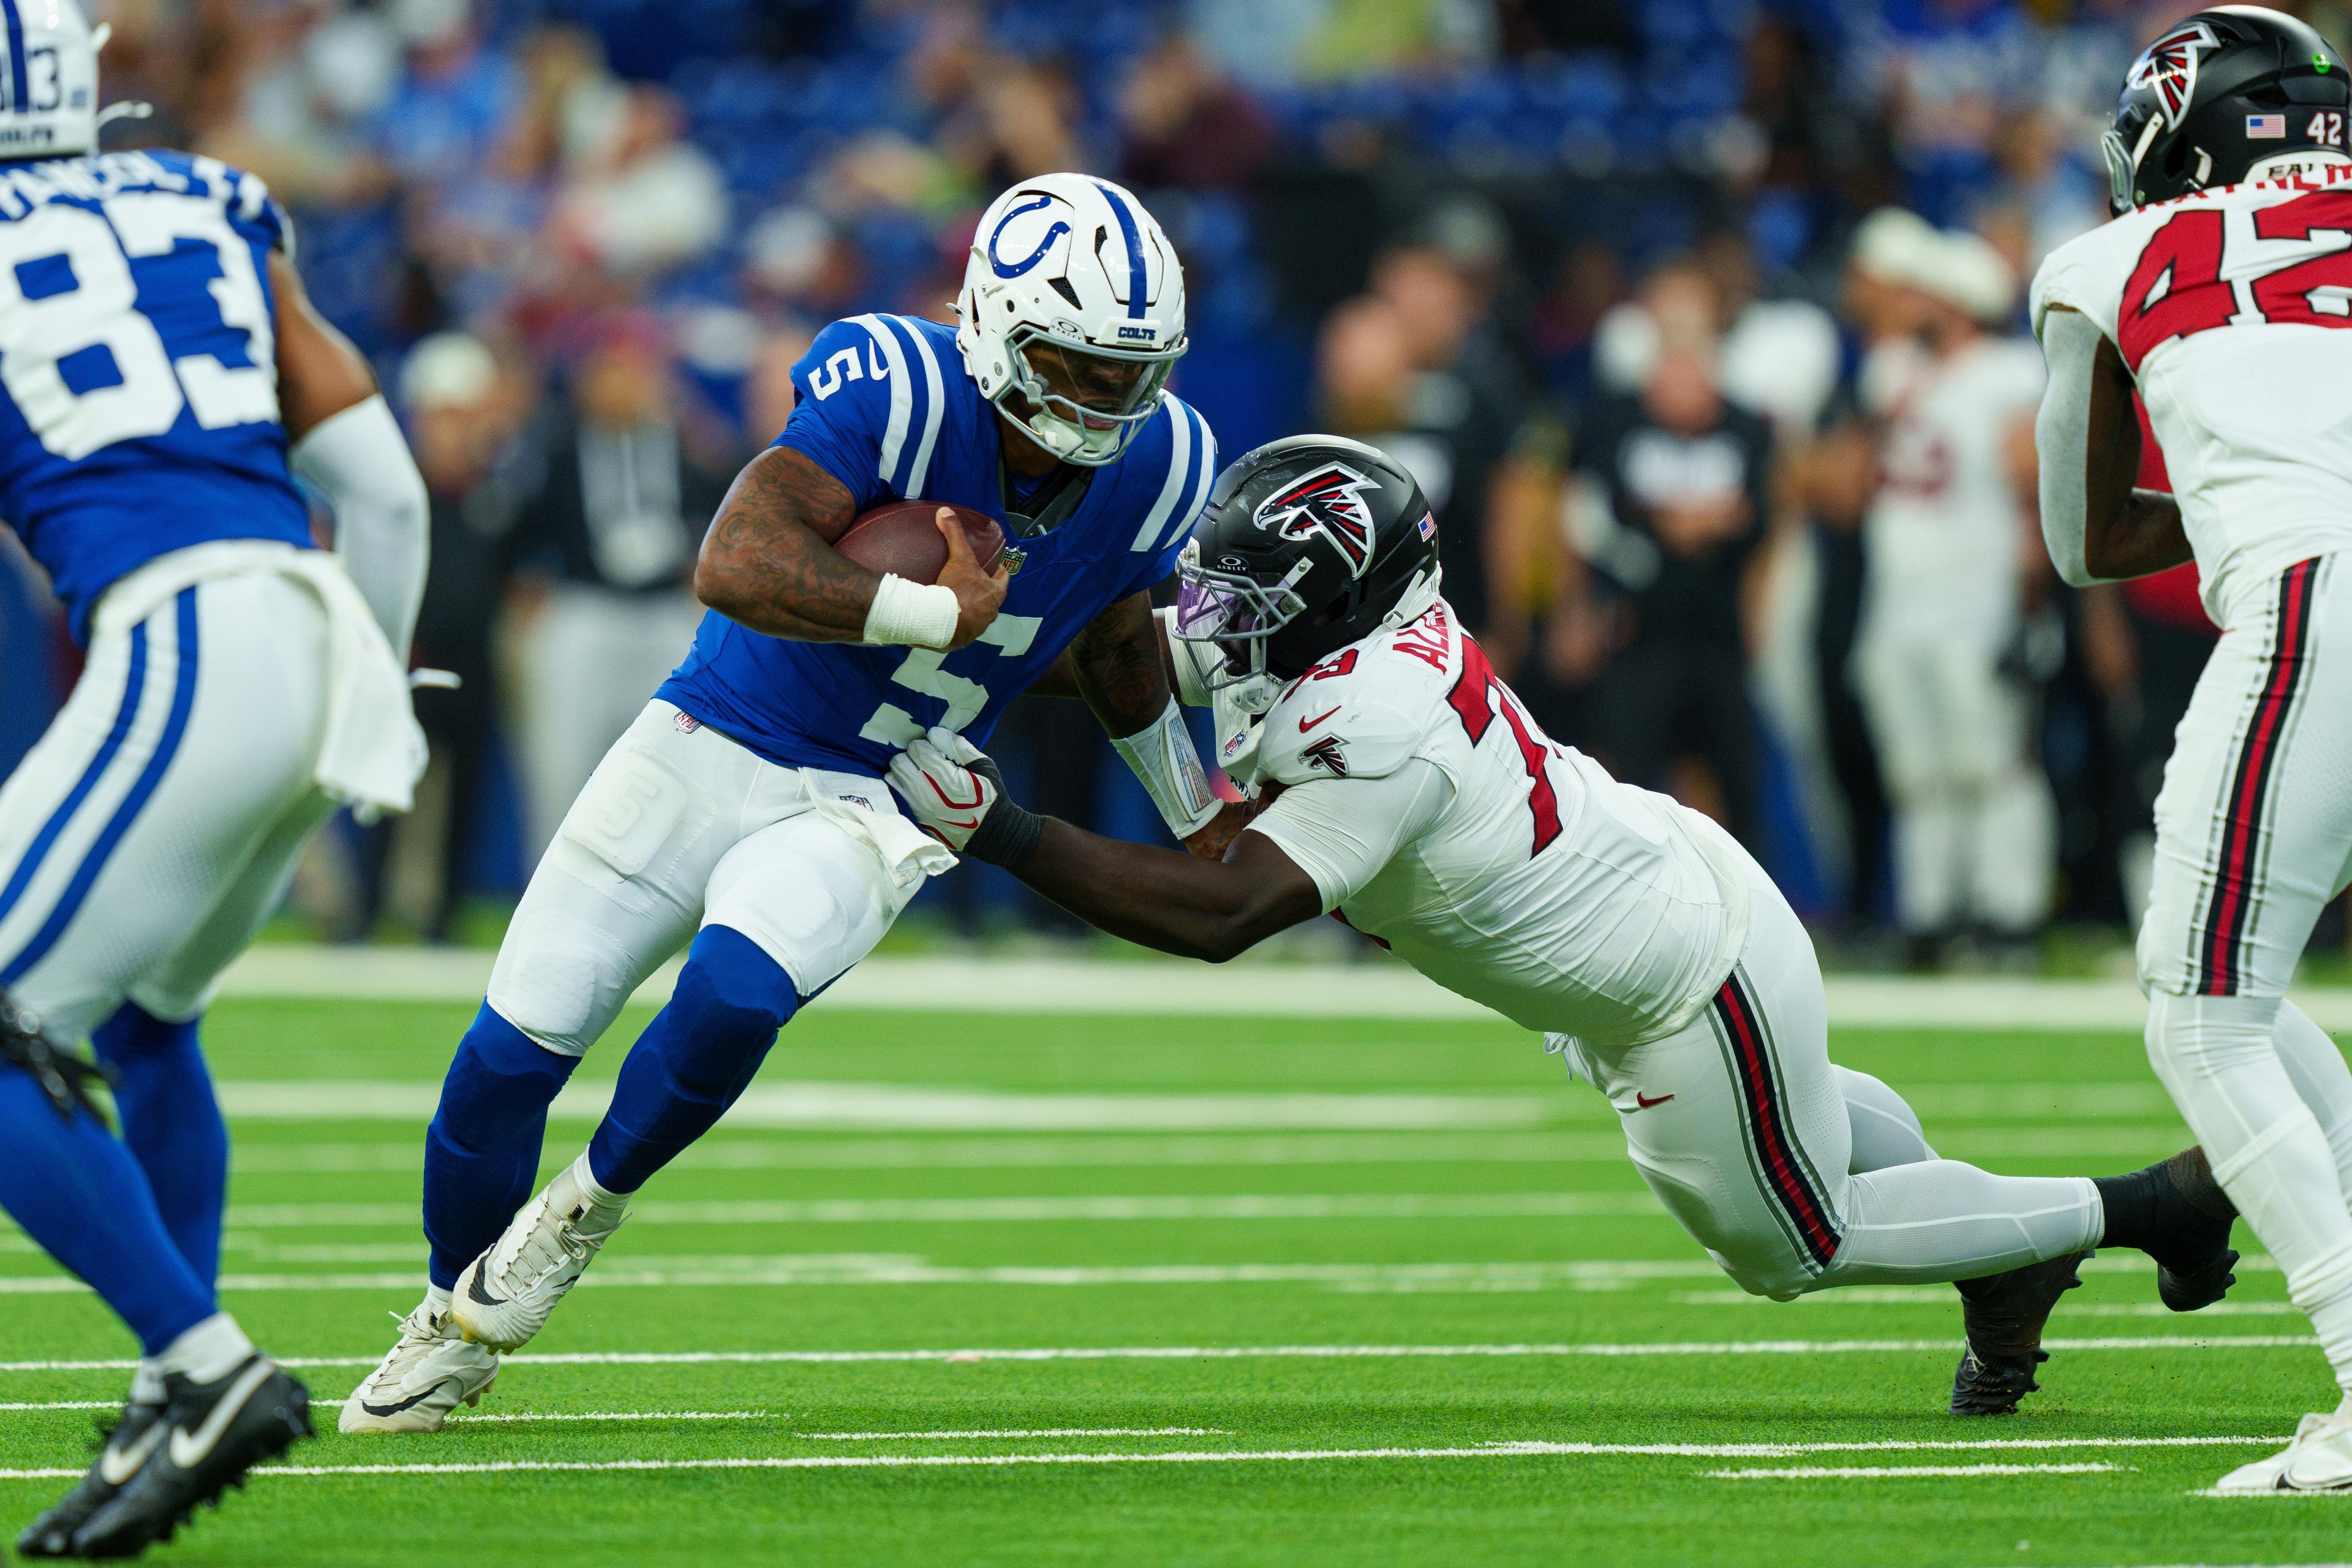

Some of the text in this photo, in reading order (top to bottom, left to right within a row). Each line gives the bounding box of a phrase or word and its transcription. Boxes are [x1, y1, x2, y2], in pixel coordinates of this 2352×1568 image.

[2307, 112, 2342, 146] 42
[2117, 189, 2352, 376] 42
[0, 190, 282, 462] 83
[1051, 325, 1082, 341] OAKLEY
[1118, 326, 1156, 340] COLTS
[808, 346, 864, 401] 5
[859, 612, 1043, 748] 5
[678, 712, 696, 729] NFL
